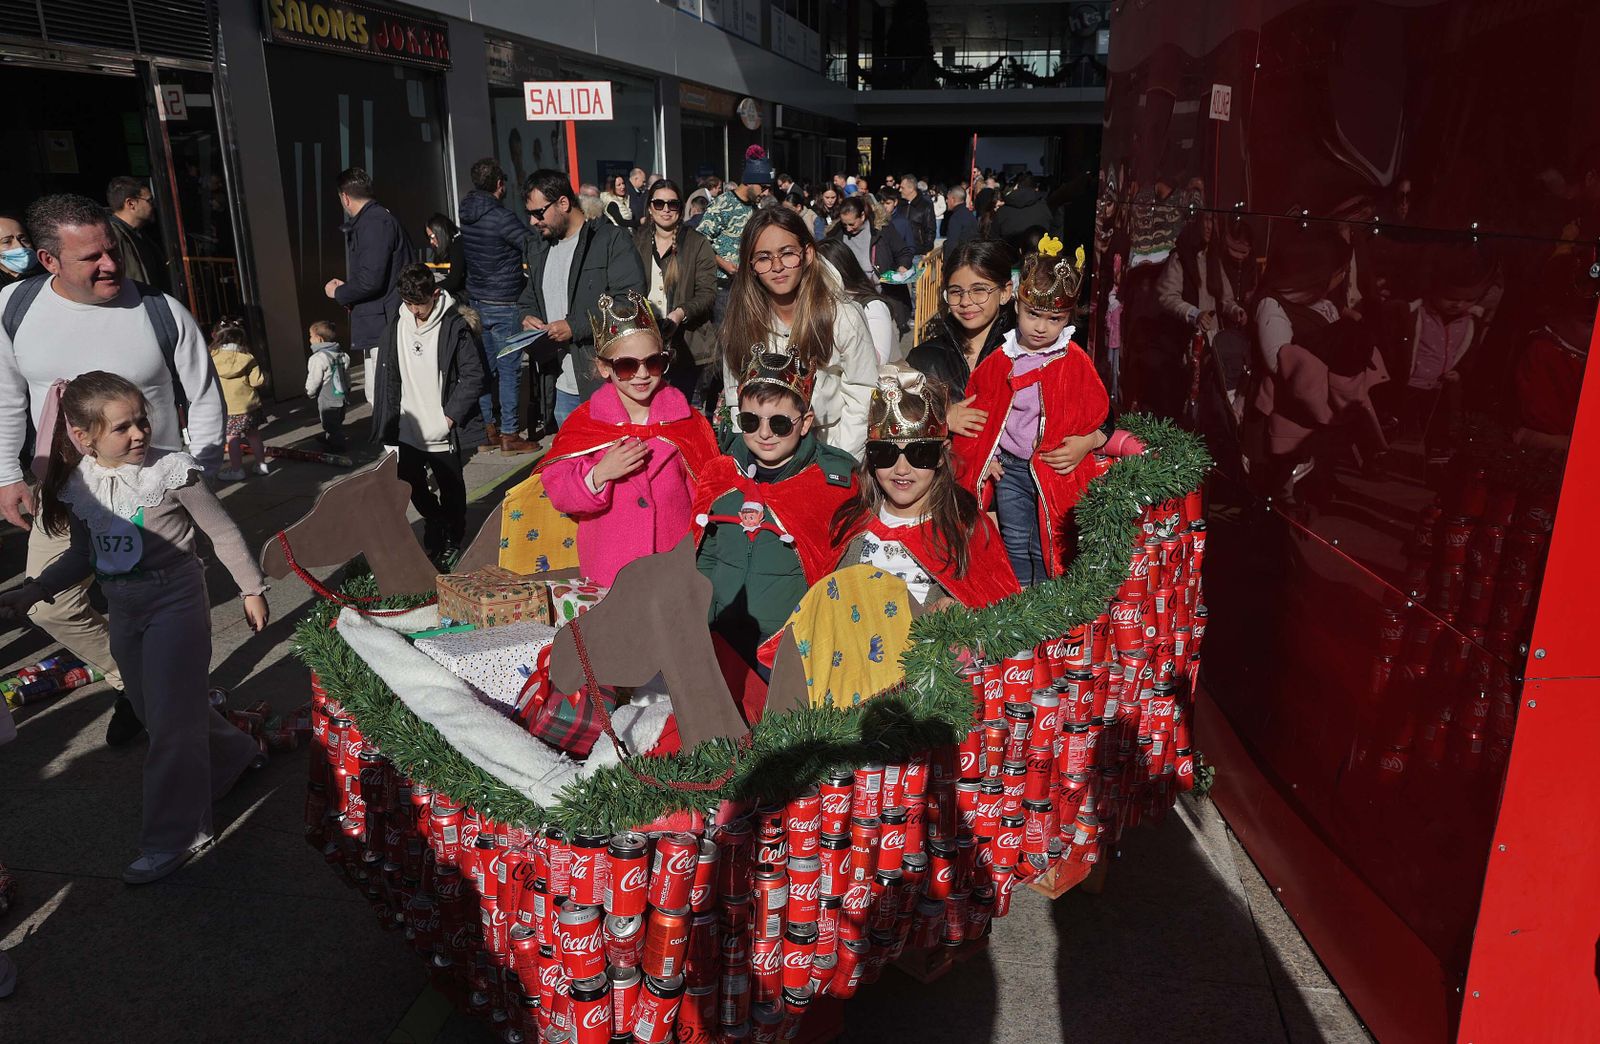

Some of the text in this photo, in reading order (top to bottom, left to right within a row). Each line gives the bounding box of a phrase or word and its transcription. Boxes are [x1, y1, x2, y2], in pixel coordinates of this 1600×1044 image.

[271, 0, 449, 60] SALONES JOKER
[530, 88, 604, 115] SALIDA
[96, 535, 134, 553] 1573
[852, 845, 870, 853] COLA
[670, 935, 688, 946] COLA
